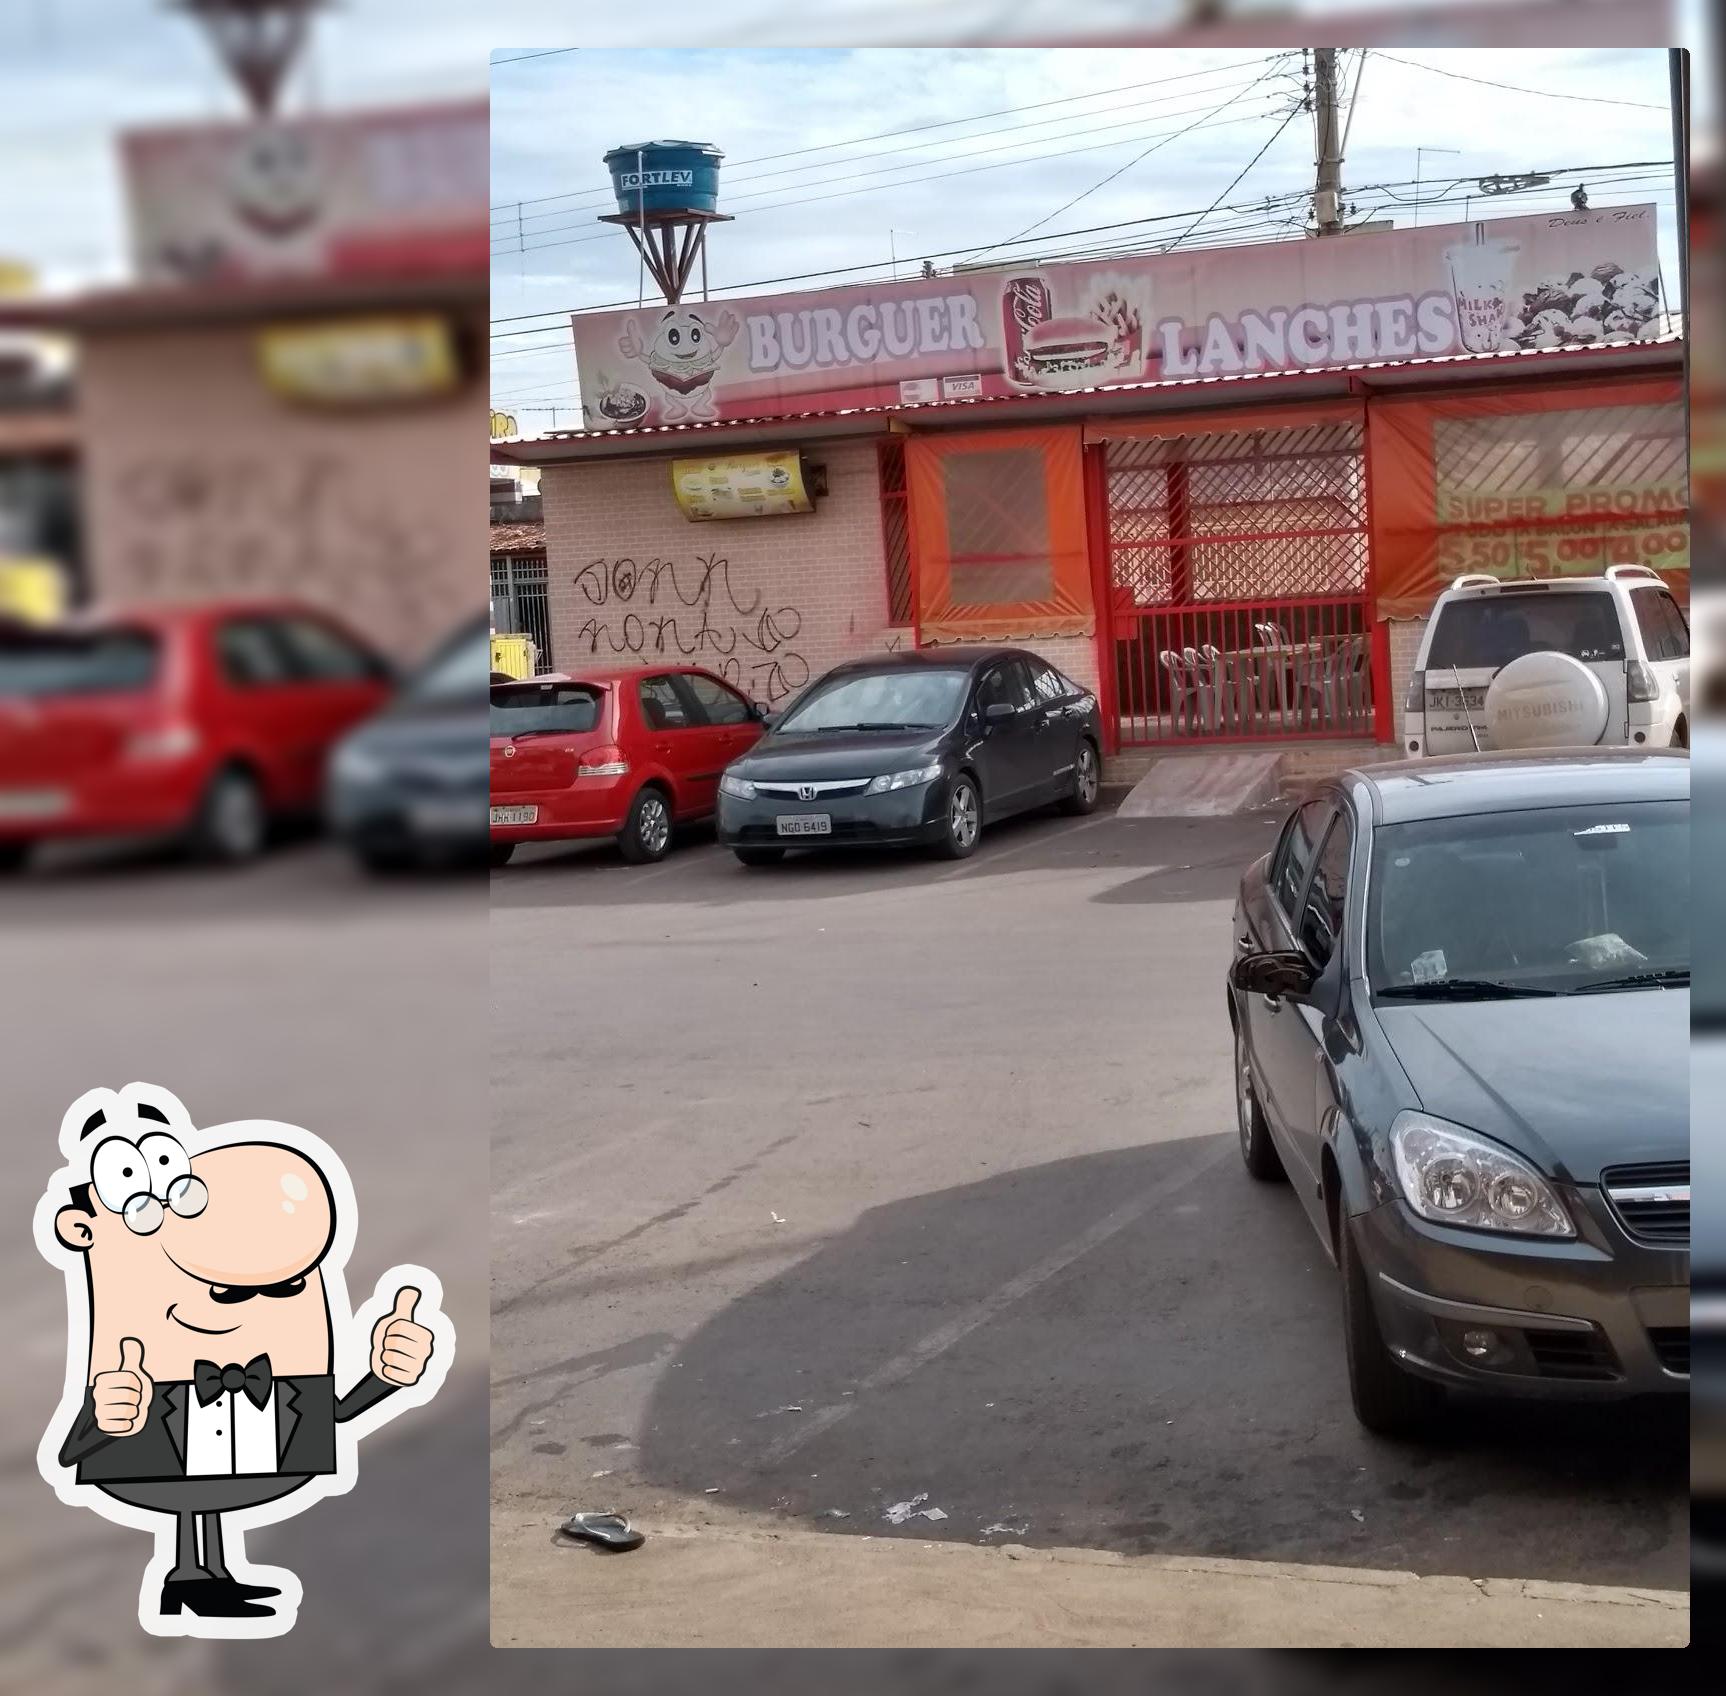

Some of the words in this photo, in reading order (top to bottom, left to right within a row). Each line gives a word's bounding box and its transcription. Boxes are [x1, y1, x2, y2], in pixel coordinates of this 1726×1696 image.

[622, 171, 691, 187] FORTLEV
[746, 293, 985, 371] BURGUER
[1158, 294, 1456, 376] LANCHES
[951, 381, 975, 391] VISA
[1449, 495, 1546, 520] SUPER
[1497, 701, 1584, 721] MITSUBISHI
[804, 820, 828, 833] 6419
